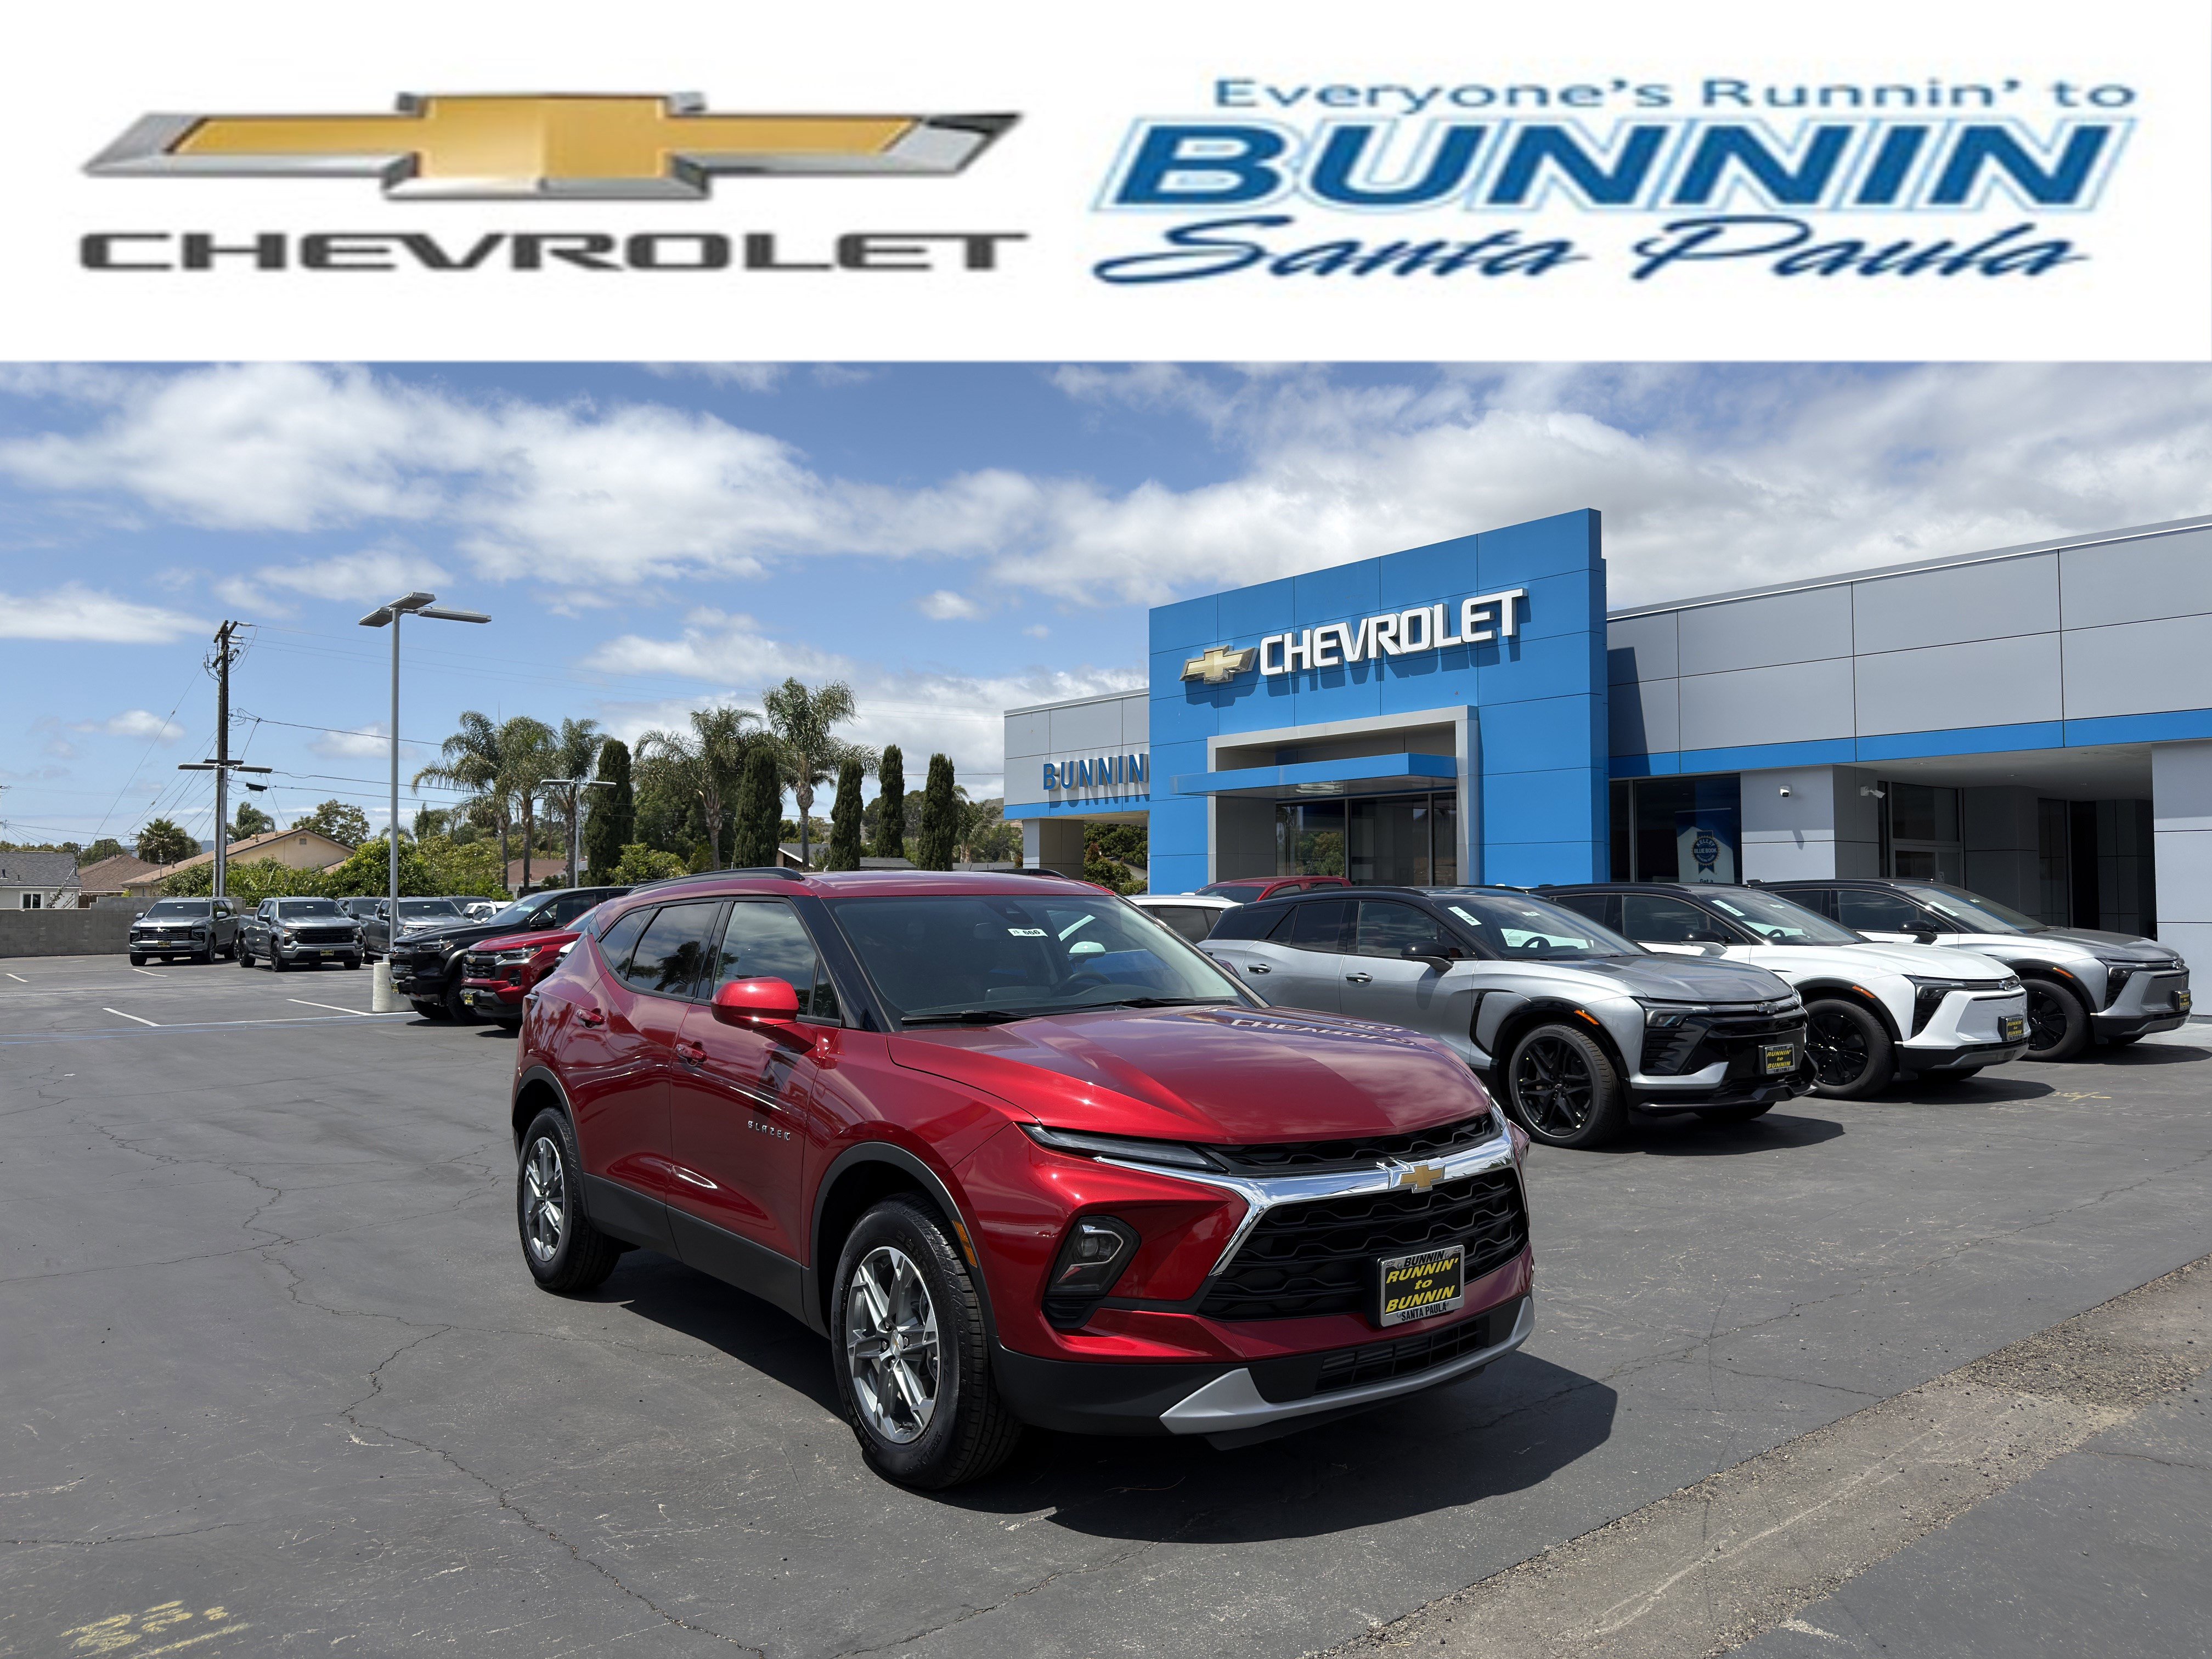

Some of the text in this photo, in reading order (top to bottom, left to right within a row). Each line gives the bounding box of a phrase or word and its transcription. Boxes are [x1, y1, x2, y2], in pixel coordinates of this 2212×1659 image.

[1260, 588, 1528, 676] CHEVROLET
[1043, 753, 1148, 790] BUNNIN
[1696, 838, 1716, 847] KELLEY
[748, 1121, 791, 1141] BLAZER
[1403, 1250, 1445, 1267] BUNNIN
[1386, 1257, 1459, 1284] RUNNIN'
[1414, 1279, 1433, 1290] to
[1385, 1285, 1455, 1313] BUNNIN
[1401, 1302, 1447, 1322] SANTA PAULA
